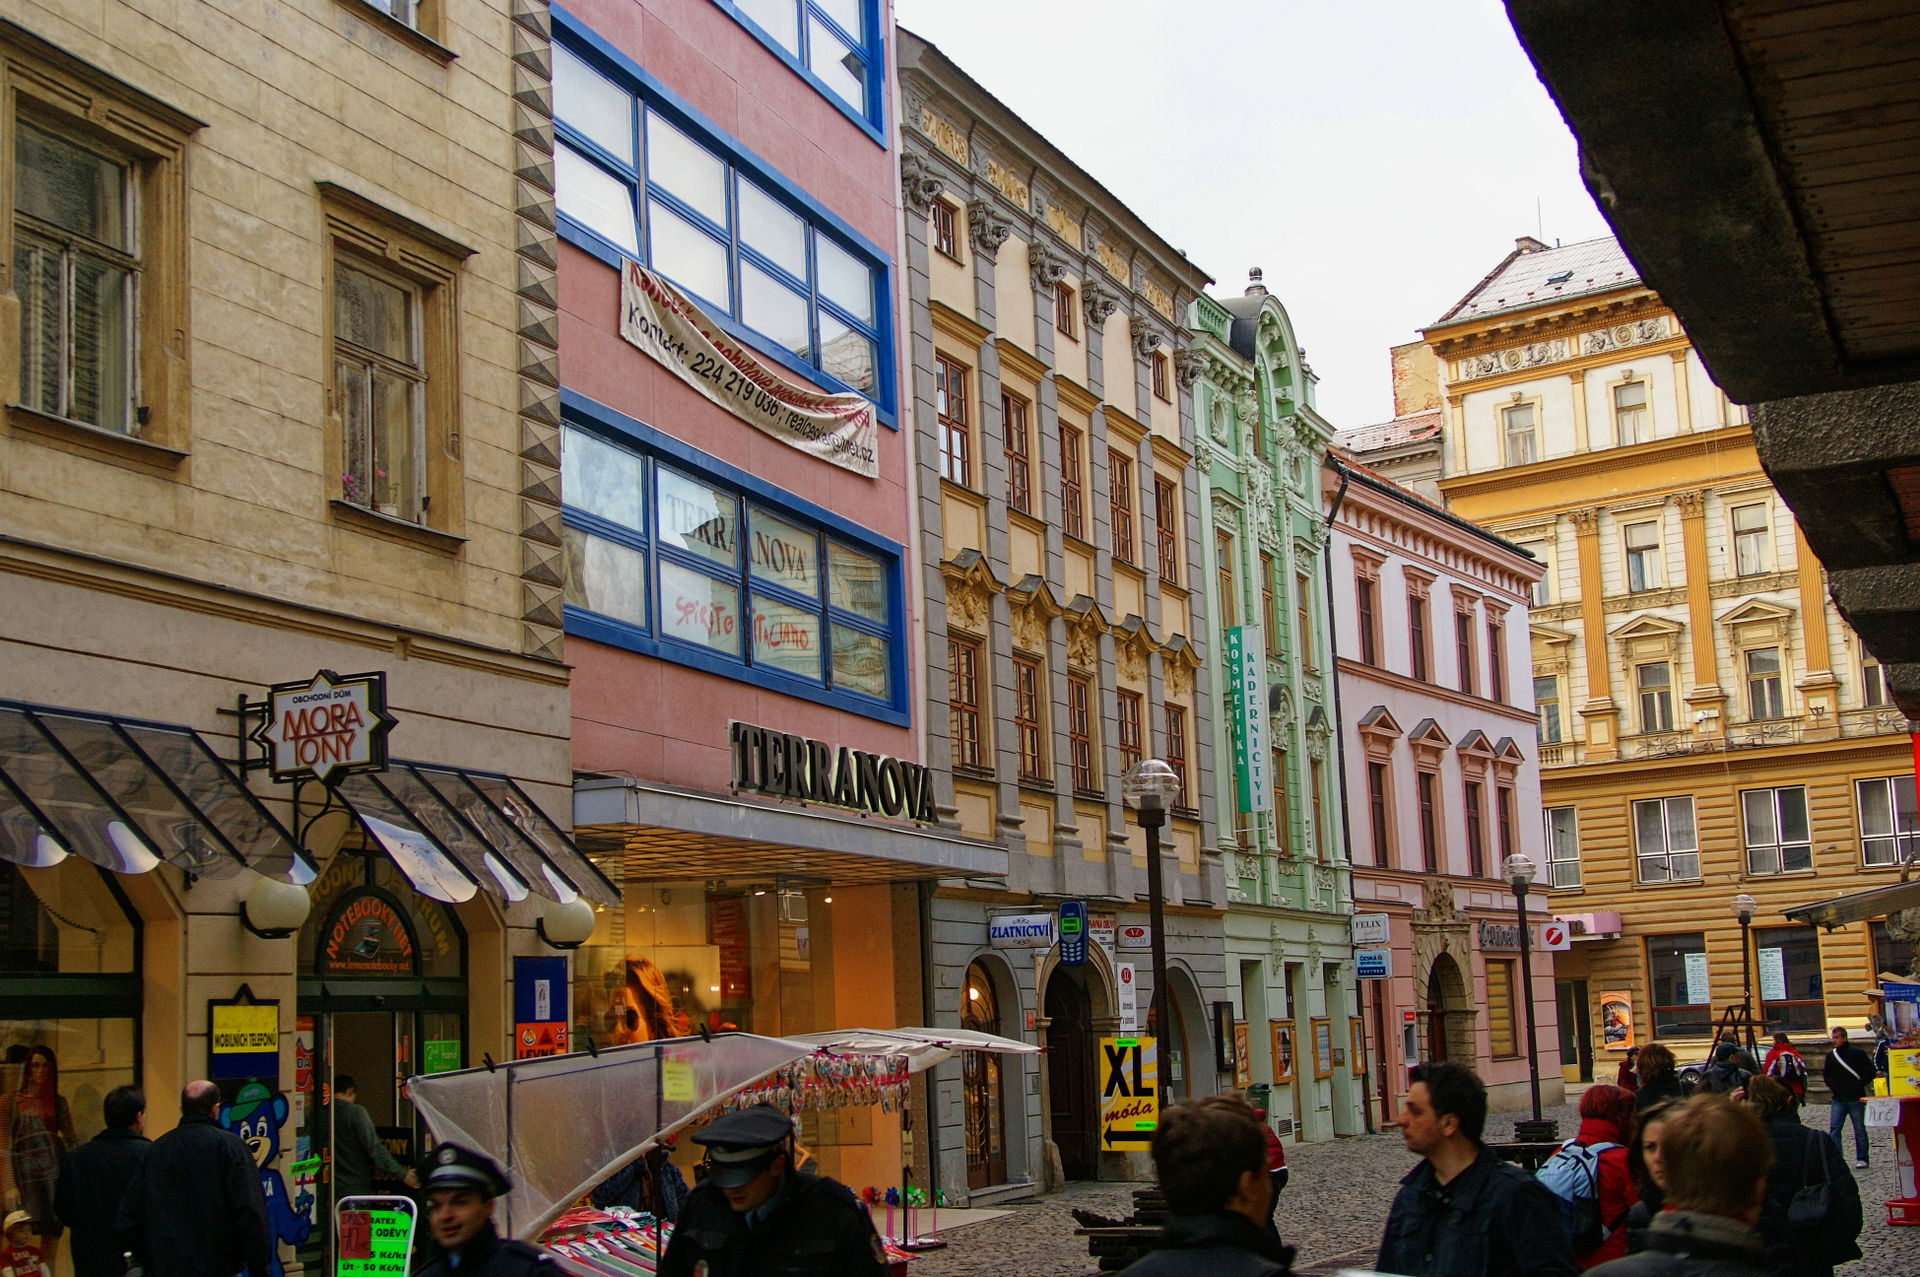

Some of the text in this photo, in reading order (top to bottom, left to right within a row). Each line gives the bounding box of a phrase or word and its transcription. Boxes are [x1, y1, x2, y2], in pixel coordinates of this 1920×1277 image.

[689, 352, 725, 384] 224
[728, 370, 756, 401] 219
[754, 394, 779, 416] 036
[292, 689, 352, 704] OBCHODNÍ DŮM
[1229, 633, 1246, 766] KOSMETIKA
[282, 701, 365, 742] MORA
[288, 728, 357, 767] TONY
[731, 721, 940, 823] TERRANOVA
[991, 922, 1049, 939] ZLATNICTVÍ
[1355, 919, 1382, 929] FELIX
[1103, 1045, 1154, 1097] XL
[1105, 1100, 1154, 1122] móda
[375, 1227, 408, 1238] ODĚVY
[363, 1263, 375, 1271] 50
